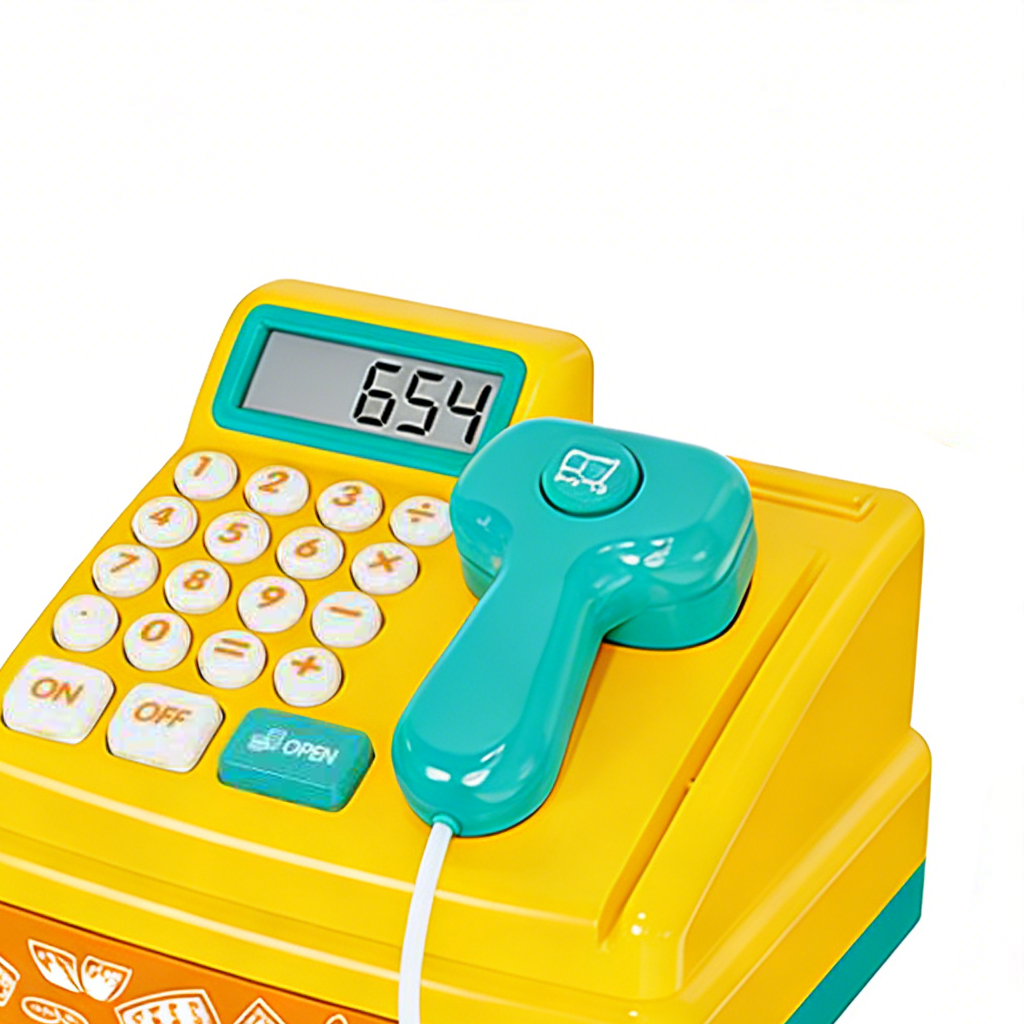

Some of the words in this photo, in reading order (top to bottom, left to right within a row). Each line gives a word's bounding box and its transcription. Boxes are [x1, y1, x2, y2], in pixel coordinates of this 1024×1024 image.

[353, 361, 492, 445] 654
[193, 455, 212, 477] 1
[258, 471, 289, 493] 2
[332, 485, 362, 508] 3
[148, 506, 176, 526] 4
[217, 522, 249, 543] 5
[293, 538, 321, 559] 6
[109, 552, 139, 573] 7
[183, 569, 212, 591] 8
[257, 585, 287, 608] 9
[140, 619, 171, 642] 0
[290, 655, 322, 677] +
[30, 677, 83, 705] ON
[133, 702, 192, 726] OFF
[282, 738, 339, 766] OPEN
